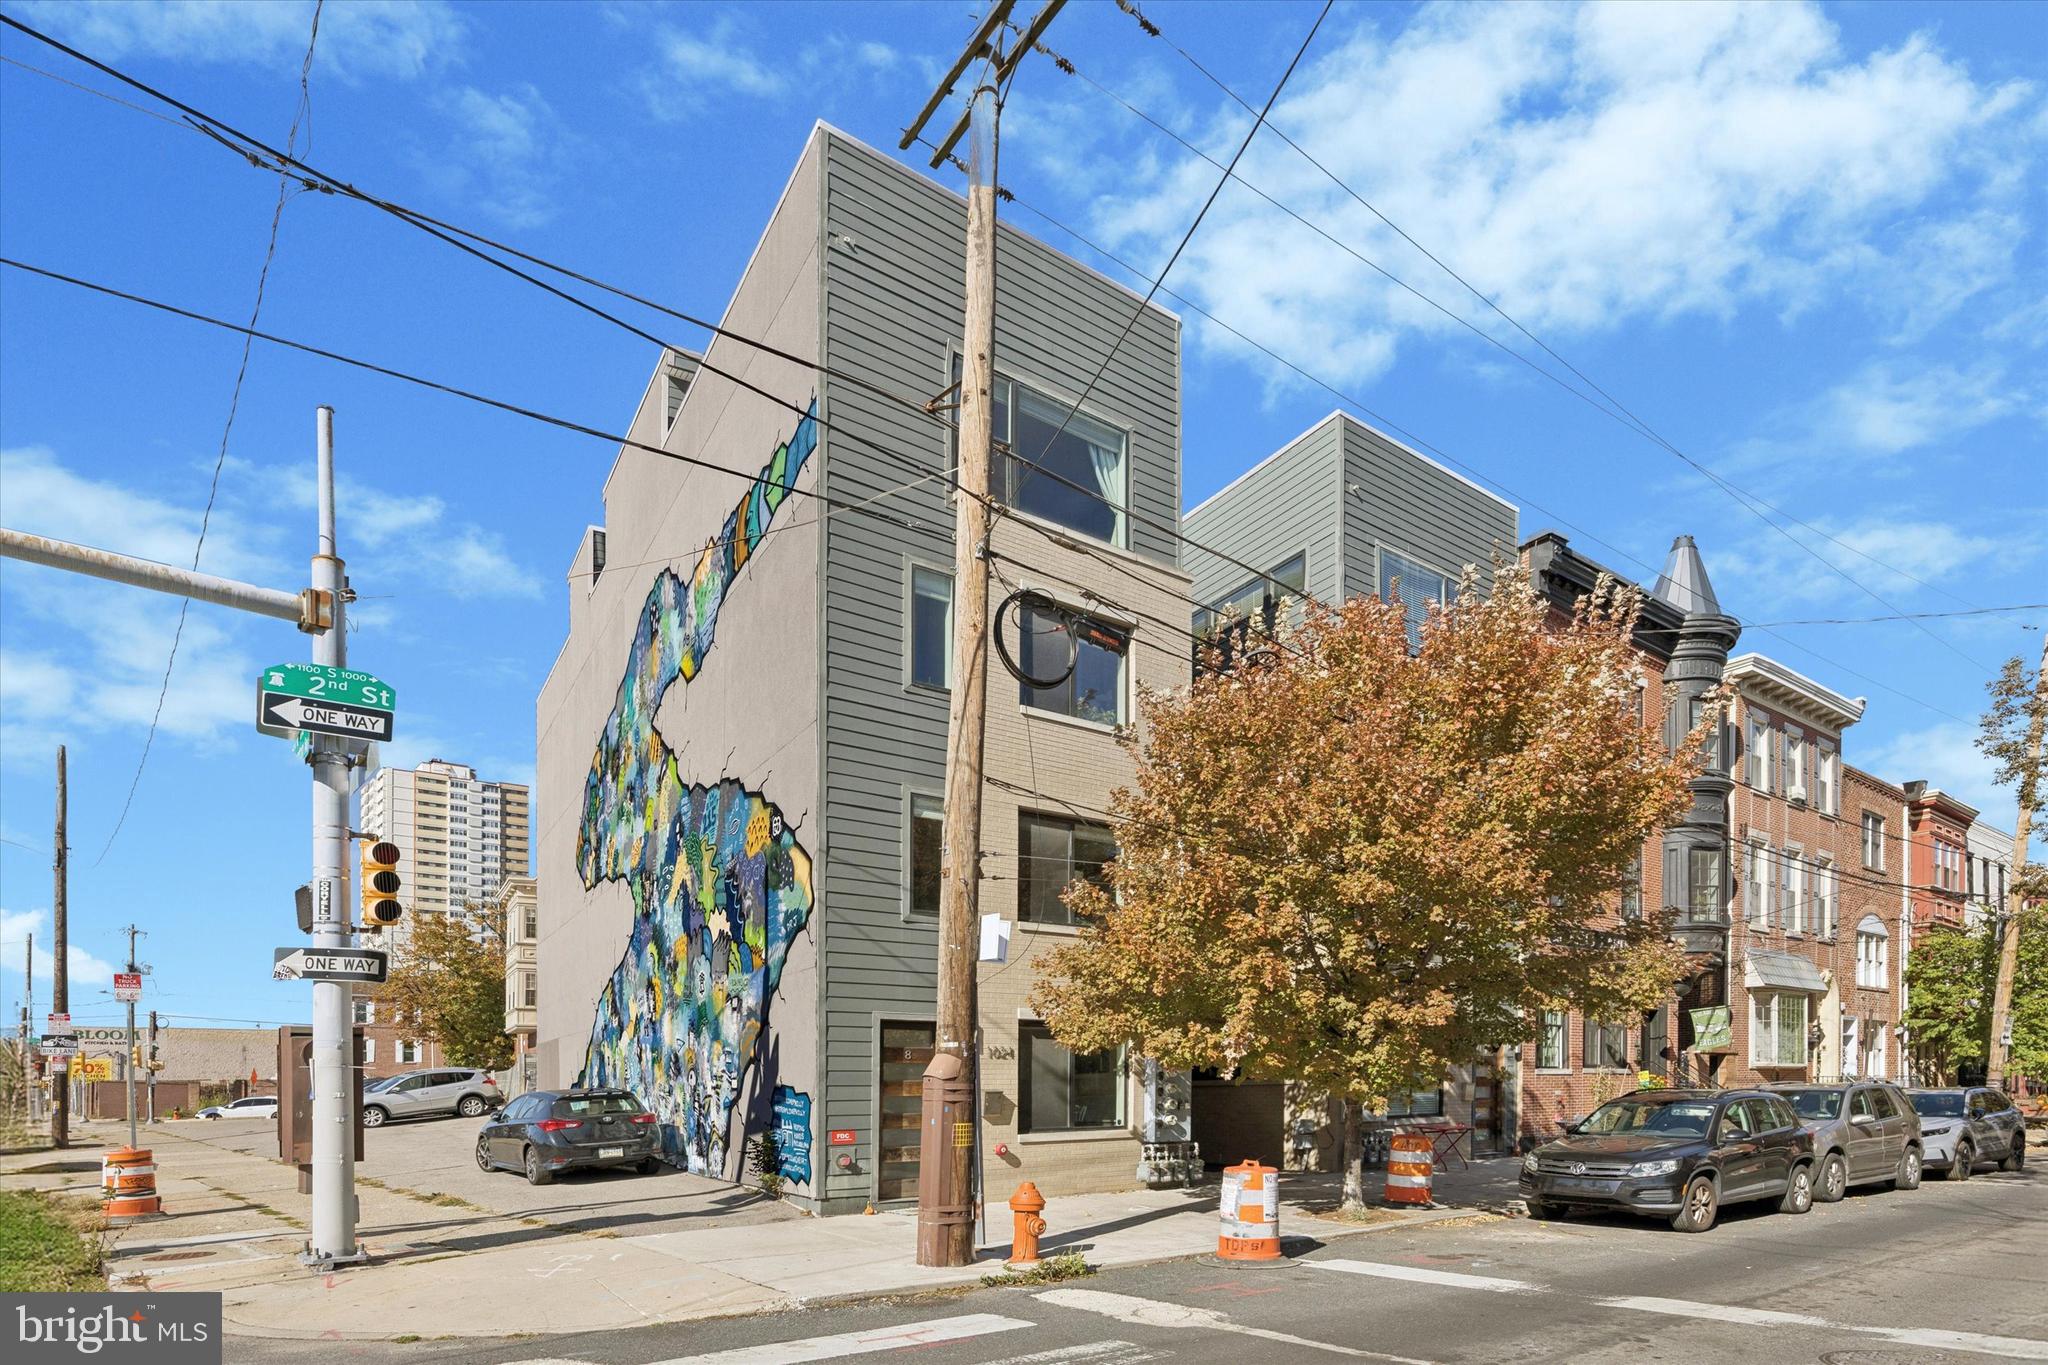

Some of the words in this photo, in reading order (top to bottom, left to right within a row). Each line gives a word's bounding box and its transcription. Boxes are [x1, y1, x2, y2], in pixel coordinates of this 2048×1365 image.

[298, 664, 321, 674] 1100
[327, 667, 337, 678] S
[341, 671, 367, 682] 1000
[308, 676, 348, 696] 2nd
[361, 686, 390, 707] St
[303, 708, 337, 724] ONE
[344, 713, 380, 730] WAY
[305, 957, 338, 971] ONE
[343, 958, 375, 972] WAY
[904, 1050, 912, 1060] 8
[987, 1046, 1015, 1060] 1024
